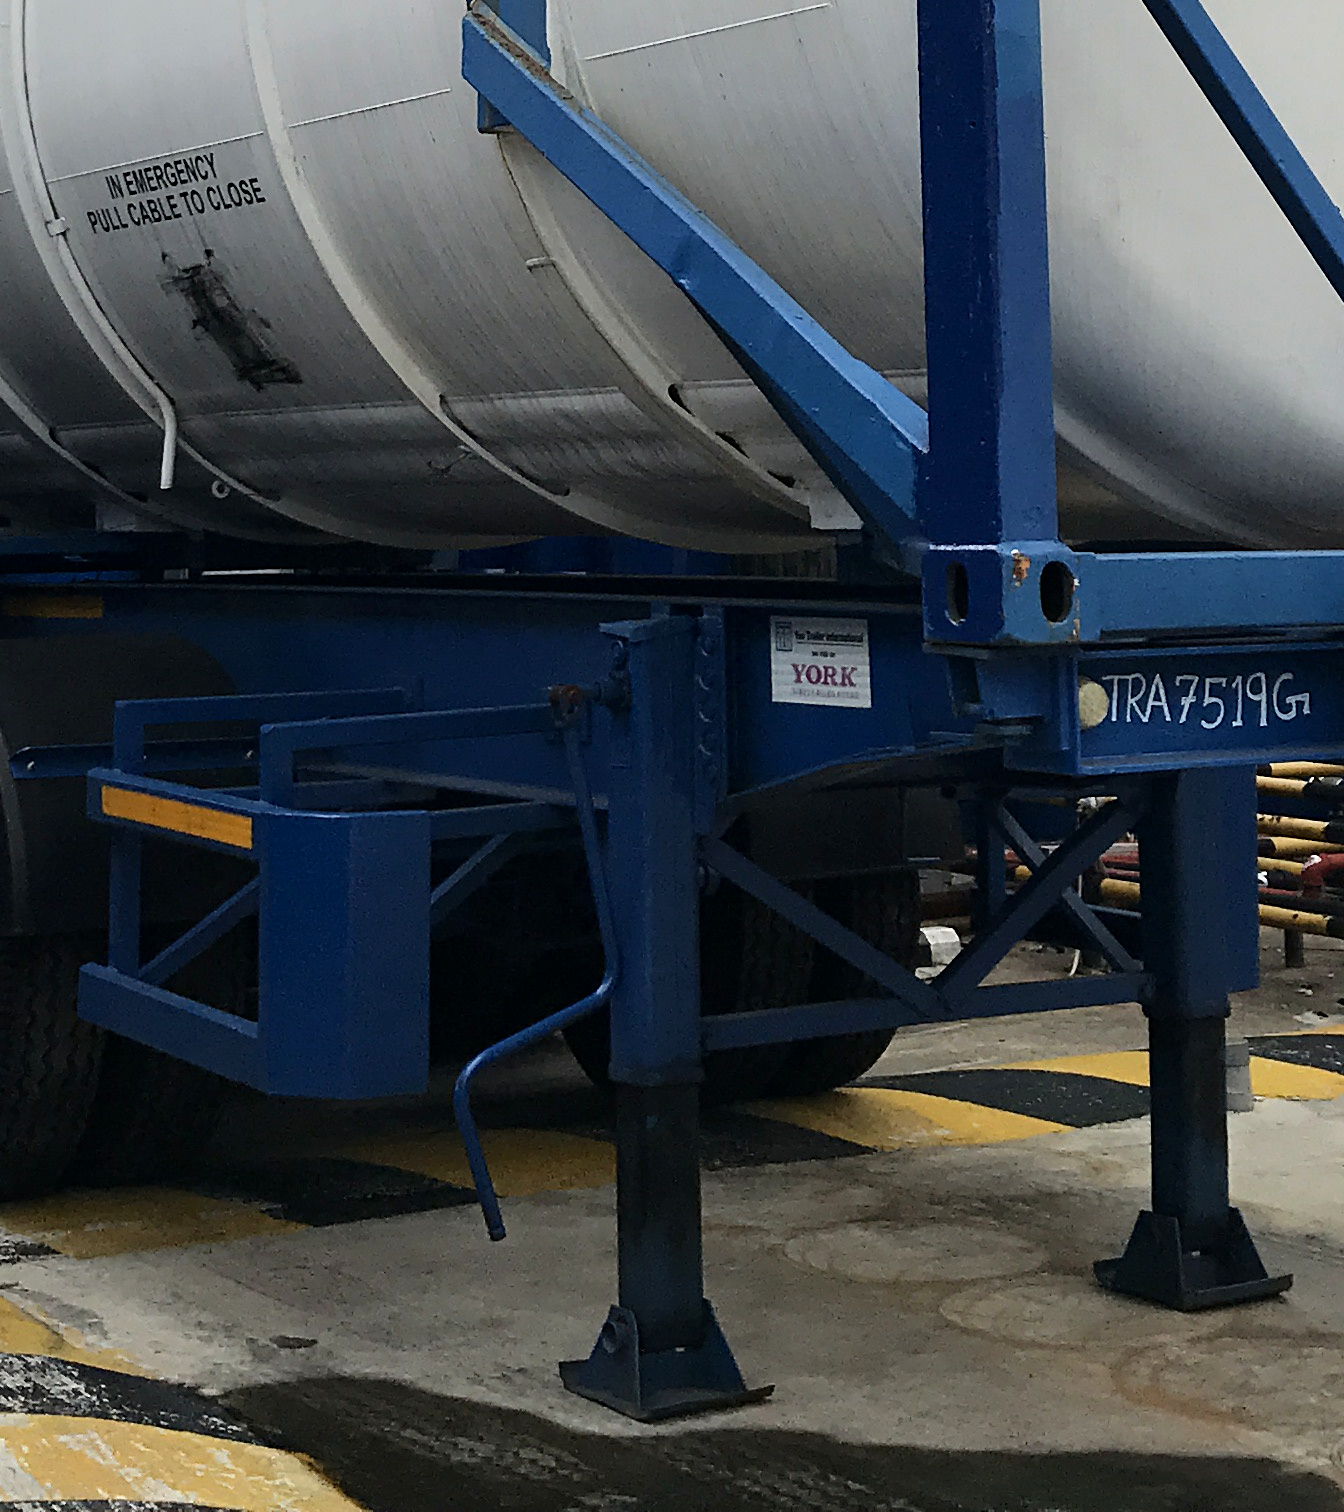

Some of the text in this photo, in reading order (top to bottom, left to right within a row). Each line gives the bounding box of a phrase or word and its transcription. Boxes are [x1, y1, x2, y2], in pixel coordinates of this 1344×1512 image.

[105, 152, 218, 200] IN EMERGENCY
[87, 177, 267, 234] PULL CABLE TO CLOSE
[790, 662, 858, 688] YORK
[1102, 671, 1312, 730] TRA7519G
